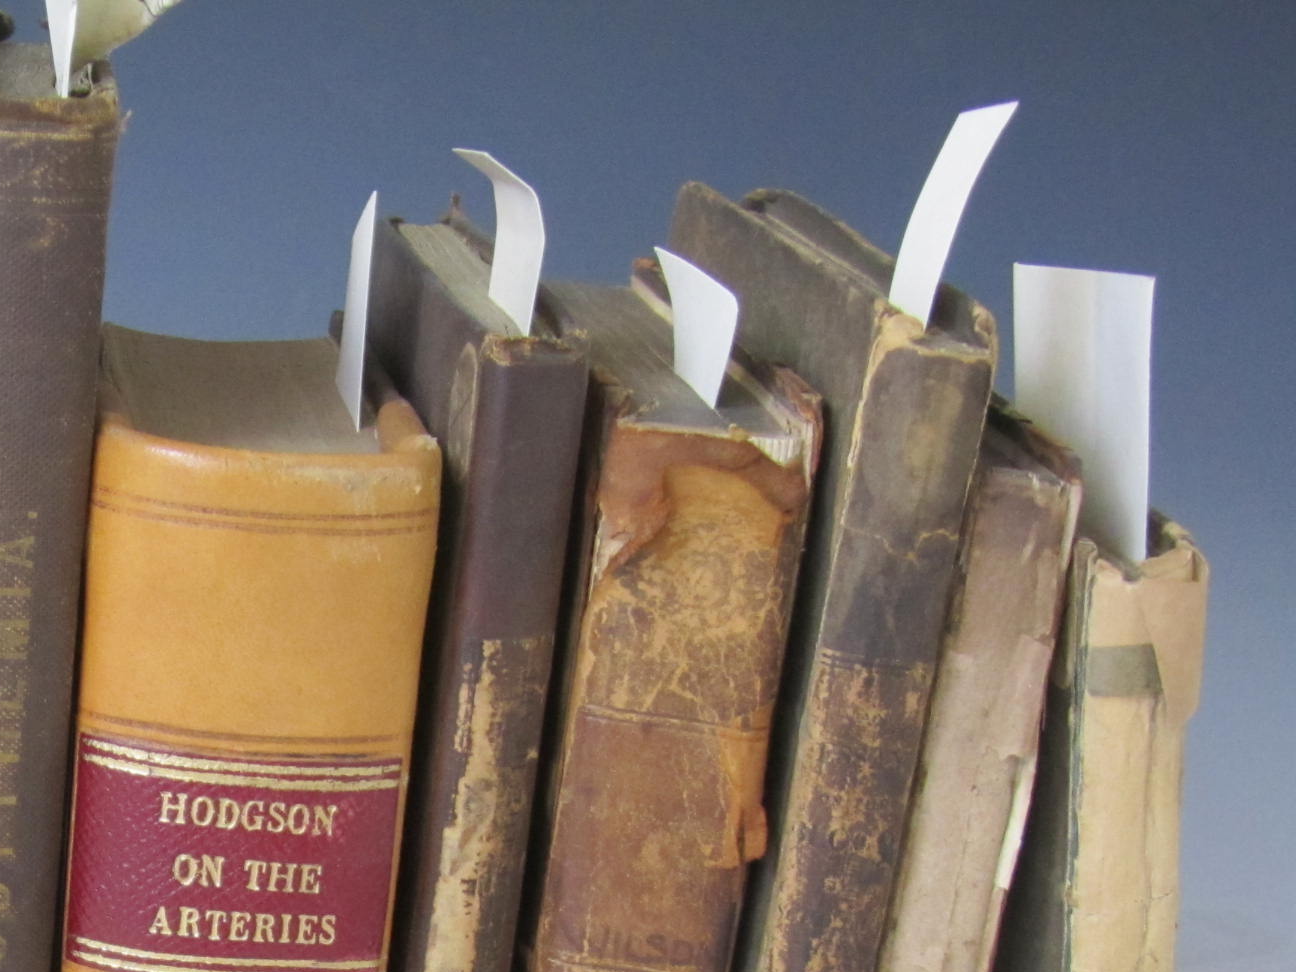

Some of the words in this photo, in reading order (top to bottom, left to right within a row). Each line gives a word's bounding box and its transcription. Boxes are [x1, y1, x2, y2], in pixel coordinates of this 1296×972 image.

[157, 791, 339, 837] HODGSON
[173, 853, 225, 888] ON
[244, 859, 323, 895] THE
[148, 906, 338, 945] ARTERIES
